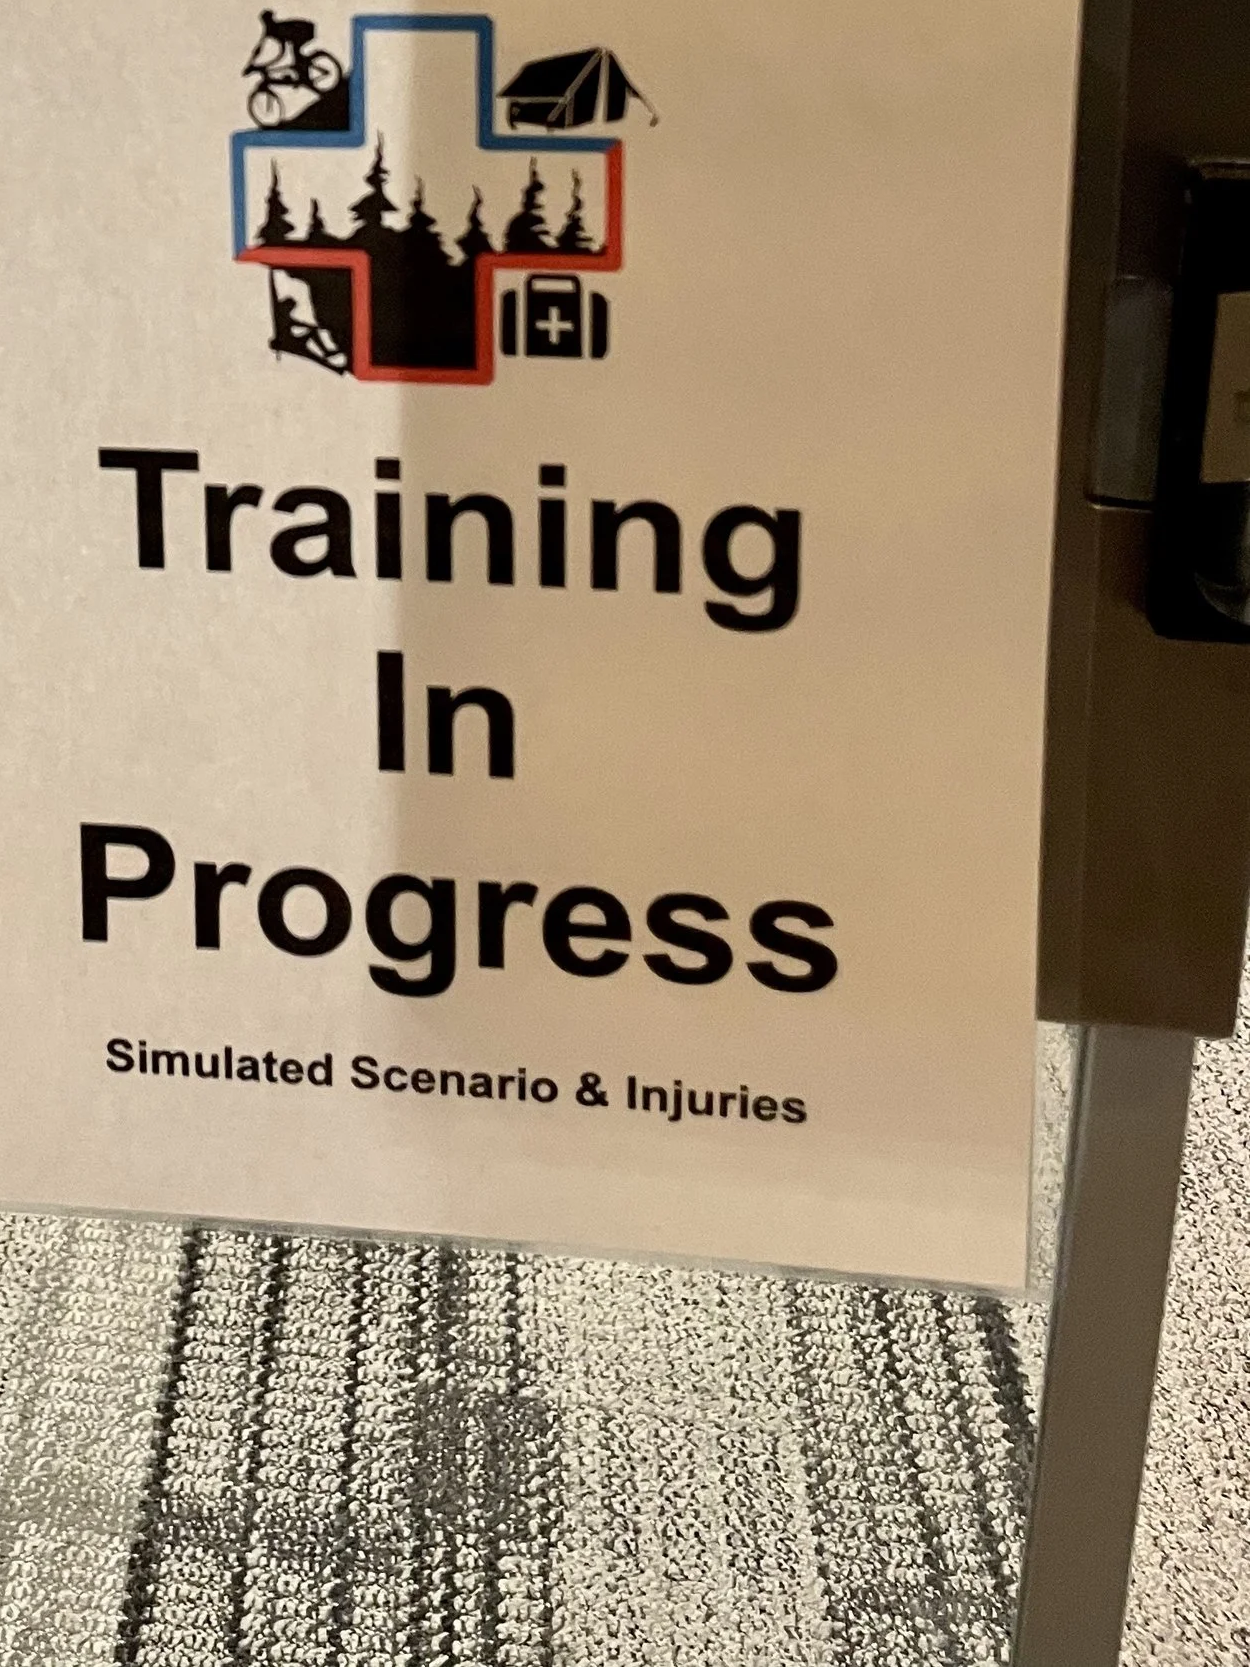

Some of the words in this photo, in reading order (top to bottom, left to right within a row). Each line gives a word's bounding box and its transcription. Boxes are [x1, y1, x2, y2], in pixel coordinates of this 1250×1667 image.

[98, 447, 801, 633] Training
[377, 650, 515, 780] In
[79, 822, 839, 998] Progress
[105, 1037, 334, 1087] Simulated
[350, 1054, 559, 1104] Scenario
[574, 1071, 610, 1108] &
[626, 1074, 809, 1125] Injuries
